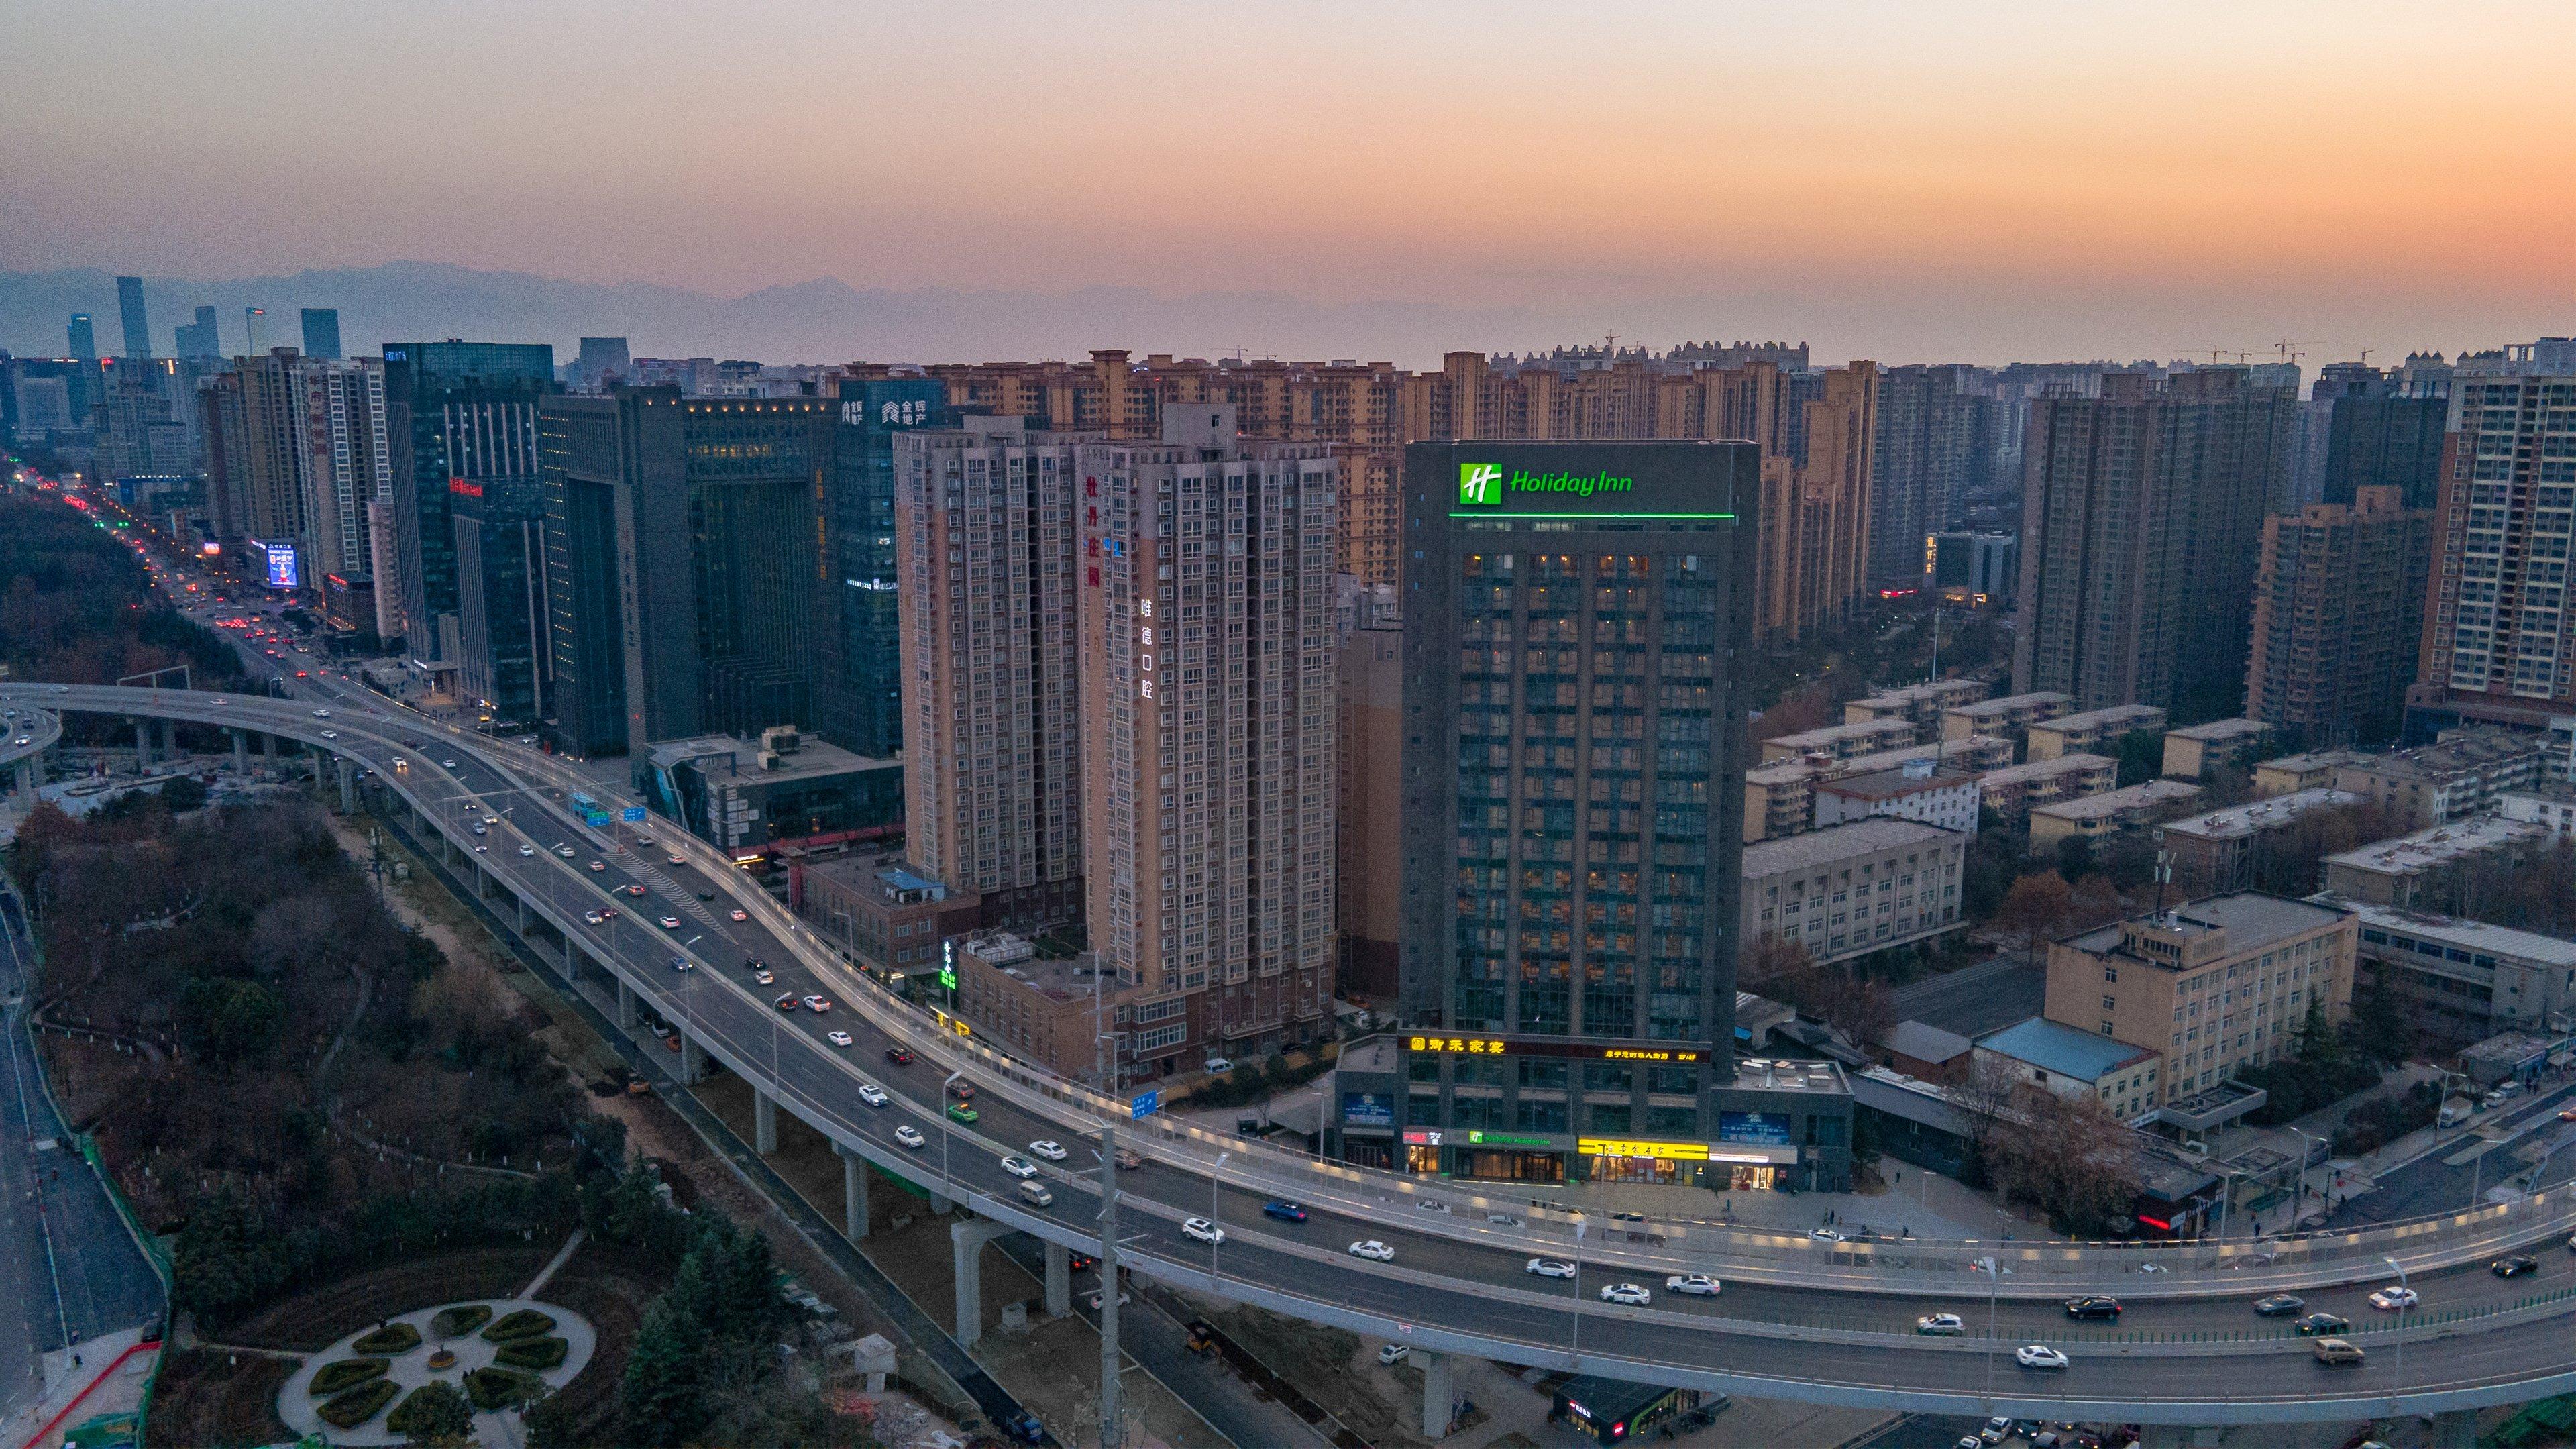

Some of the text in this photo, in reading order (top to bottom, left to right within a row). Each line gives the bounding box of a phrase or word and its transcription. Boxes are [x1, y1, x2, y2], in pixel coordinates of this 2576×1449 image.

[902, 400, 926, 413] 金辉
[902, 413, 926, 425] 地产
[1510, 470, 1633, 497] Holiday Inn
[1086, 476, 1100, 587] 牡丹庄园
